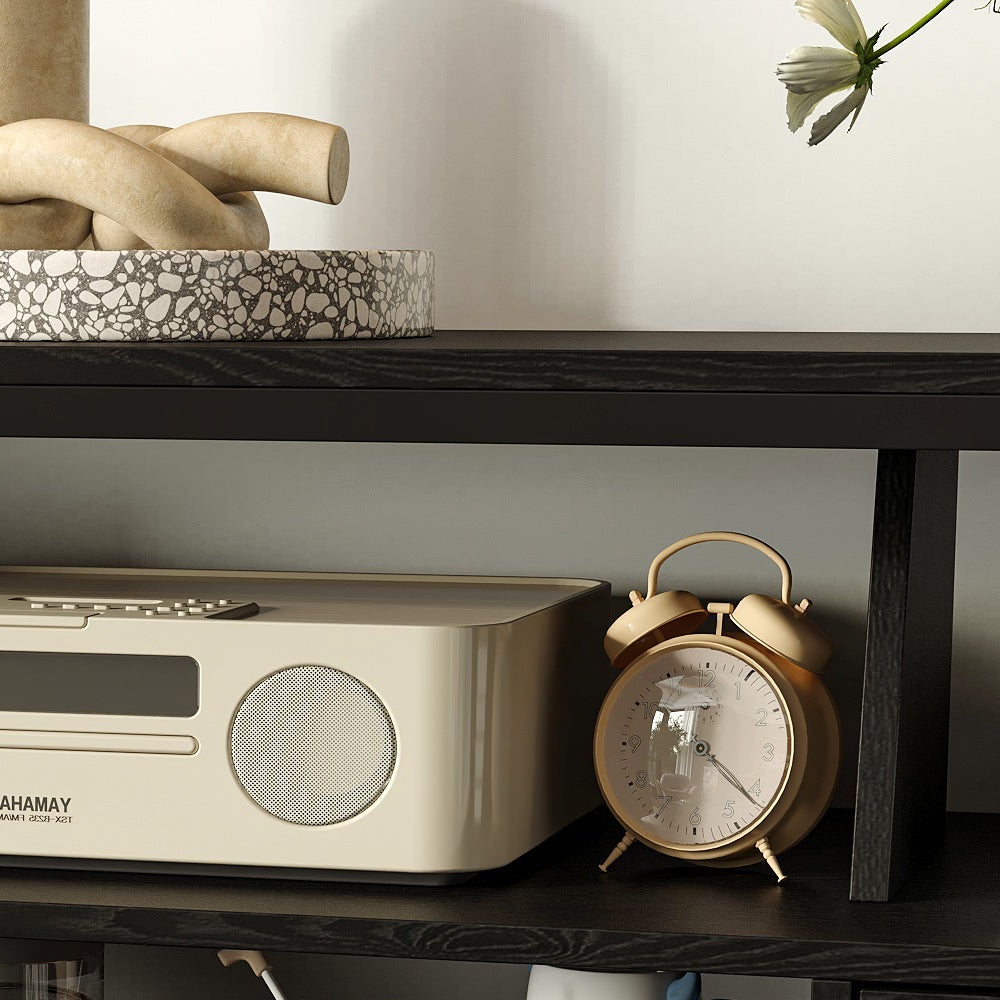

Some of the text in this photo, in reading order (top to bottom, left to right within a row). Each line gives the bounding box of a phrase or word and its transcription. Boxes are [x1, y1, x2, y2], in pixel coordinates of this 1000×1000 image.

[696, 669, 716, 689] 12
[735, 682, 741, 700] 1
[755, 708, 767, 726] 2
[629, 735, 641, 753] 9
[762, 743, 774, 762] 3
[636, 770, 647, 788] 8
[747, 778, 762, 797] 4
[658, 795, 673, 815] 7
[722, 800, 735, 818] 5
[689, 807, 701, 825] 6
